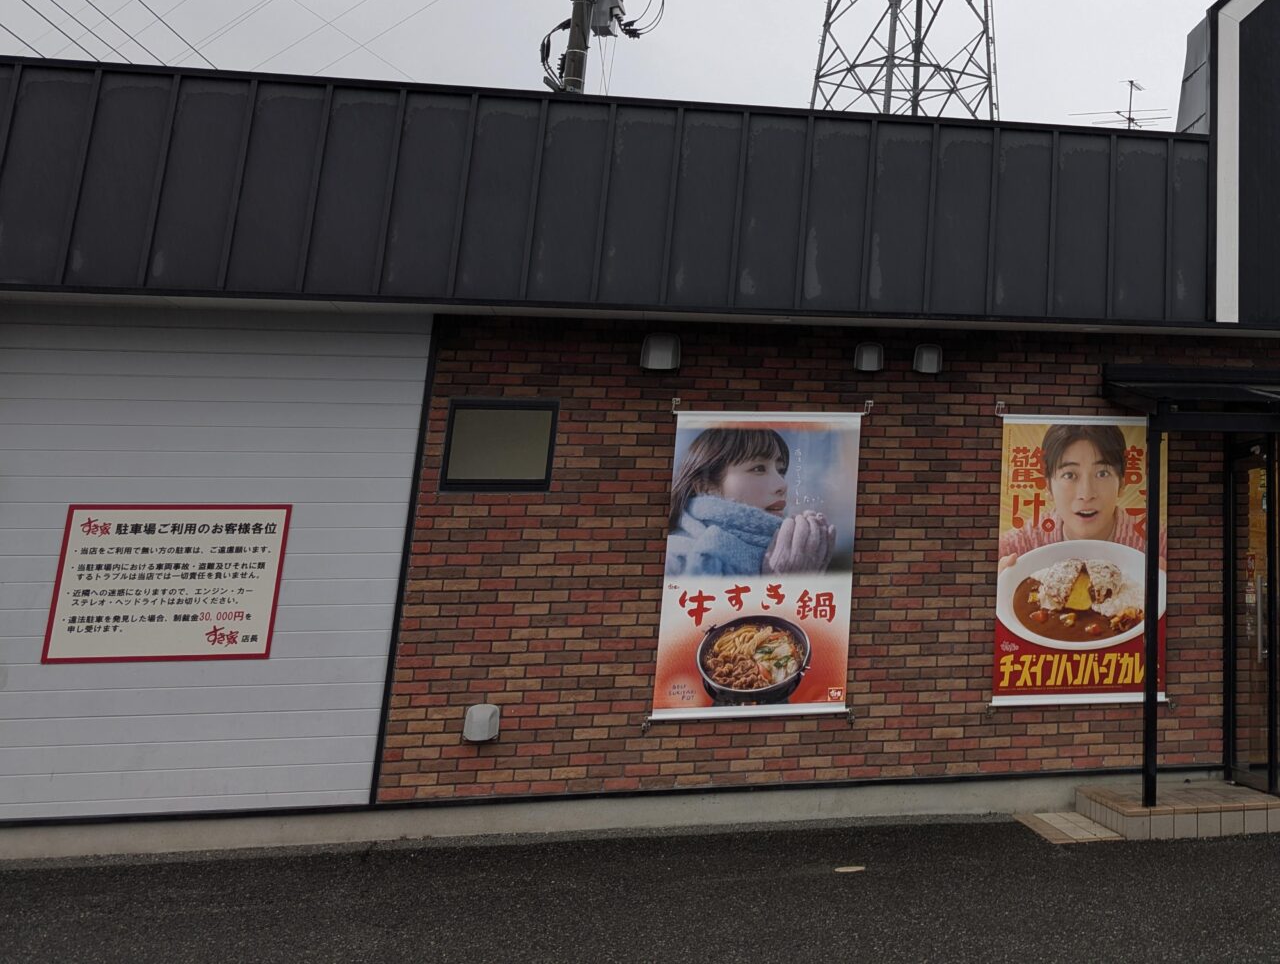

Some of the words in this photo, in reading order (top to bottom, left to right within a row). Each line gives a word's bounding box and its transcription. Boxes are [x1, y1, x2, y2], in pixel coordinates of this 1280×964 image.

[115, 522, 278, 536] 駐車場ご利用のお客様各位
[679, 584, 837, 627] 牛すき鍋
[999, 651, 1160, 687] チーズインハンバーグカレ
